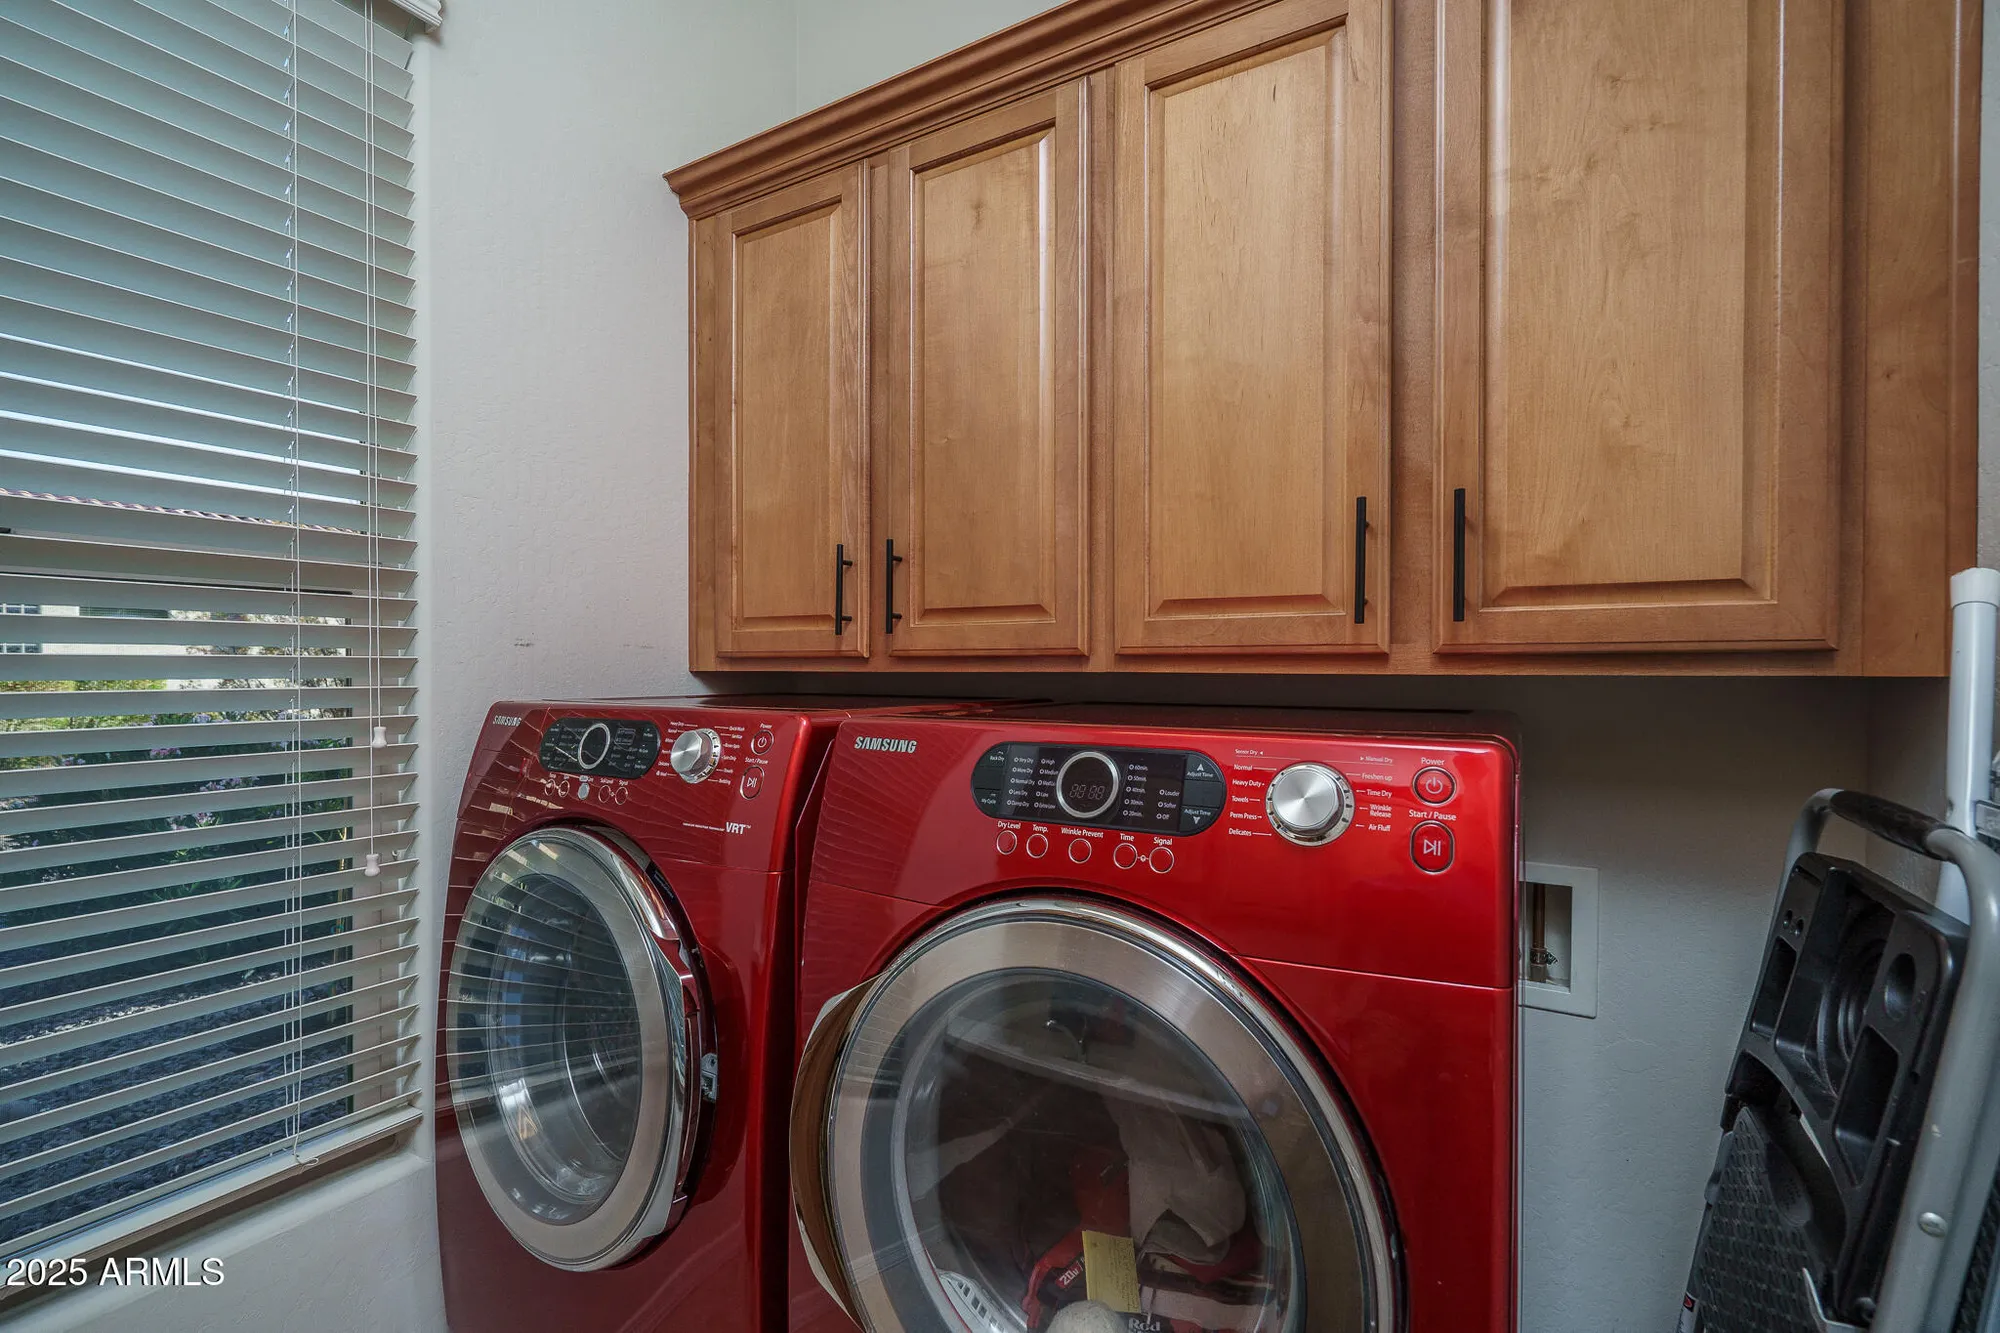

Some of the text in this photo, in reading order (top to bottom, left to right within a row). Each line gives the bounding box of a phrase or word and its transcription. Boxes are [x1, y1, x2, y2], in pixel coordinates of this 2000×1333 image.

[492, 714, 522, 727] SAMSUNG
[759, 722, 773, 730] Power
[854, 735, 918, 754] SAMSUNG
[1234, 748, 1258, 757] Sensor Dry
[1365, 754, 1393, 764] Manual Dry
[1420, 756, 1446, 767] Power
[1233, 764, 1253, 772] Normal
[1361, 772, 1393, 783] Freshen up
[1232, 778, 1262, 789] Heavy Duty
[1366, 788, 1393, 799] Time Dry
[1231, 795, 1249, 804] Towels
[1184, 808, 1212, 817] Adjust Time
[1369, 803, 1392, 812] Wrinkle
[1229, 811, 1257, 821] Perm Press
[1369, 809, 1392, 819] Release
[1408, 809, 1428, 819] Start
[1433, 811, 1457, 821] Pause
[997, 820, 1021, 831] Dry Level
[1032, 823, 1049, 834] Temp.
[1368, 823, 1391, 832] Air Fluff
[1060, 826, 1104, 839] Wrinkle Prevent
[1119, 832, 1135, 842] Time
[1228, 827, 1252, 837] Delicates
[1153, 836, 1173, 847] Signal
